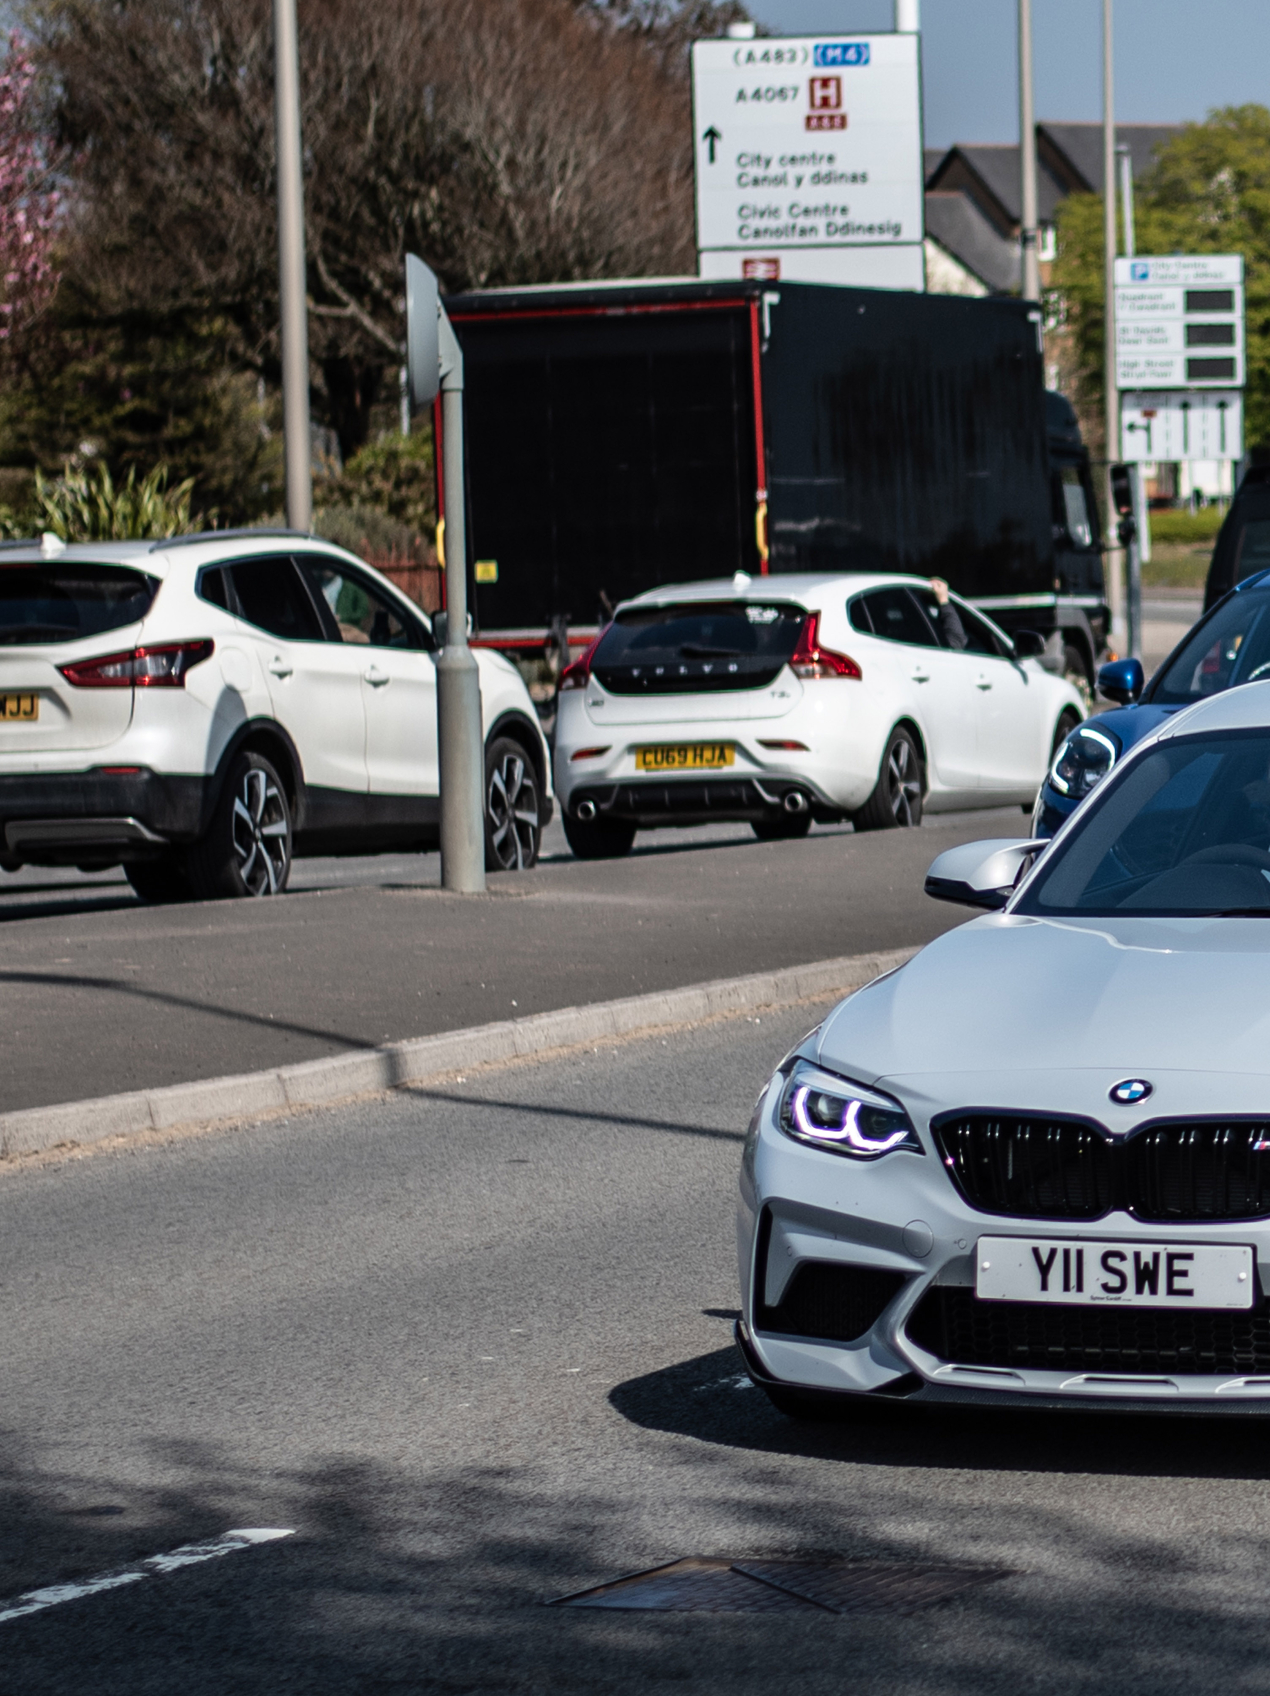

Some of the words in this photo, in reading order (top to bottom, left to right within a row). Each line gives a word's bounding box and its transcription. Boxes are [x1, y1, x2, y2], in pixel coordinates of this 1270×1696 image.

[815, 44, 868, 65] (M4)
[736, 86, 799, 103] A4067
[813, 78, 837, 108] H
[736, 152, 772, 169] City
[778, 151, 835, 168] centre
[736, 171, 788, 188] Canol
[794, 174, 805, 188] y
[810, 170, 869, 186] ddinas
[737, 204, 781, 220] Civic
[788, 202, 850, 219] Centre
[737, 222, 819, 240] Canolfan
[825, 220, 902, 238] Ddinesig
[642, 747, 687, 767] CU69
[692, 745, 728, 765] HJA
[1100, 1250, 1195, 1298] SWE
